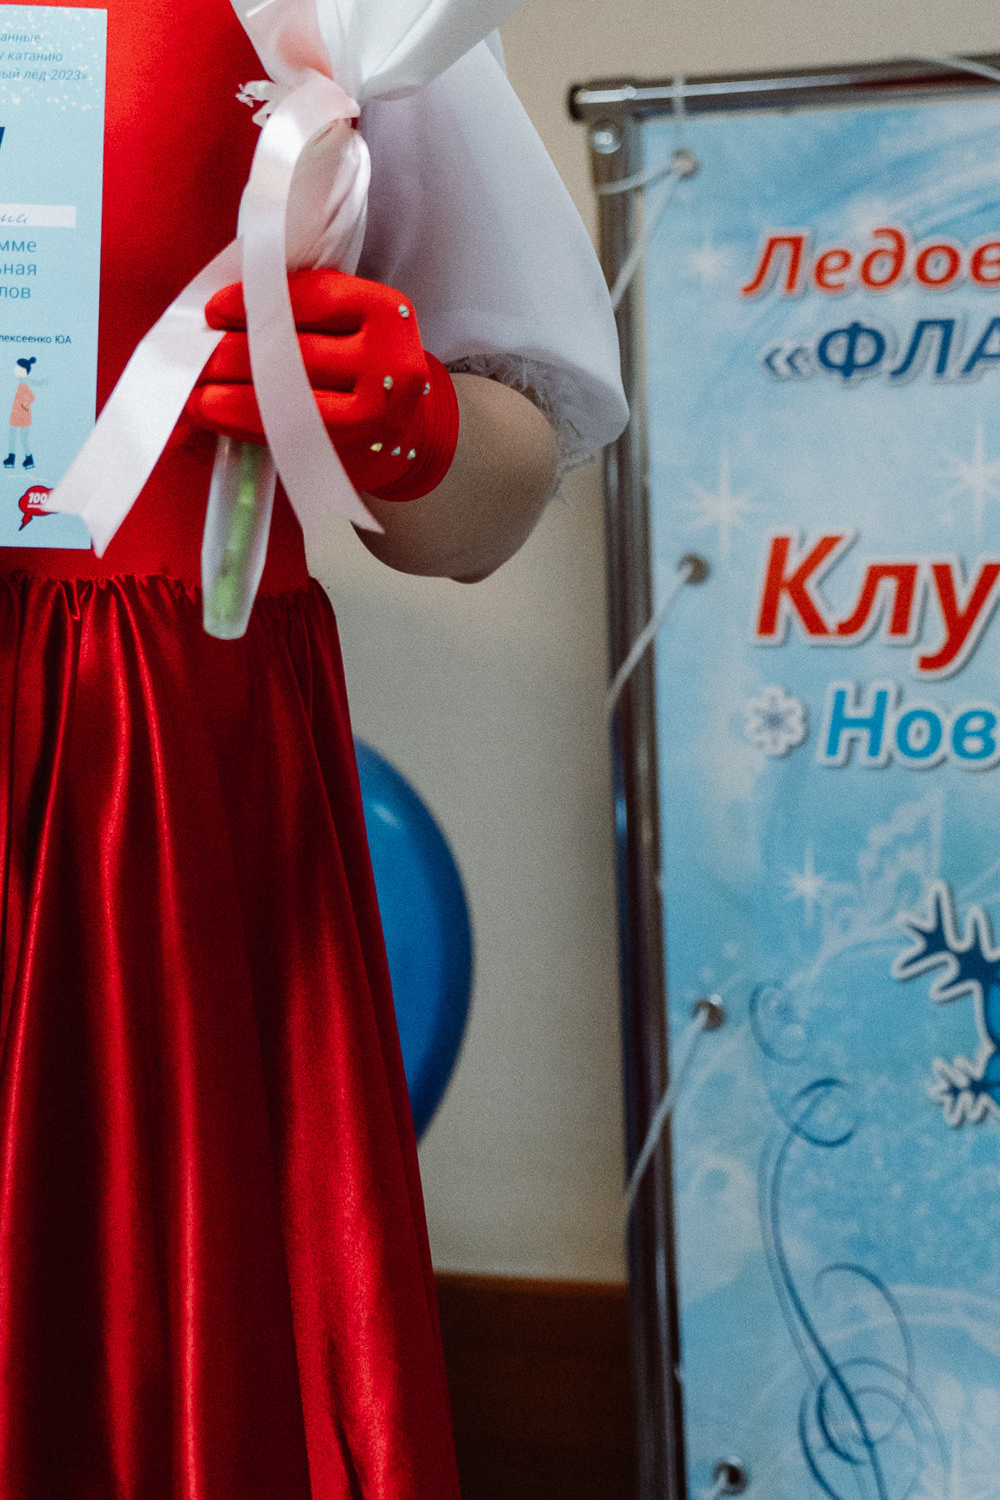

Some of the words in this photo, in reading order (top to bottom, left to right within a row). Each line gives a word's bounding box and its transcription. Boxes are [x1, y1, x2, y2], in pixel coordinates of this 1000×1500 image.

[7, 52, 63, 62] катанию
[23, 69, 88, 81] лёд-2023»
[55, 334, 72, 344] ЮА
[755, 534, 1000, 671] Клу
[826, 689, 998, 761] Нов
